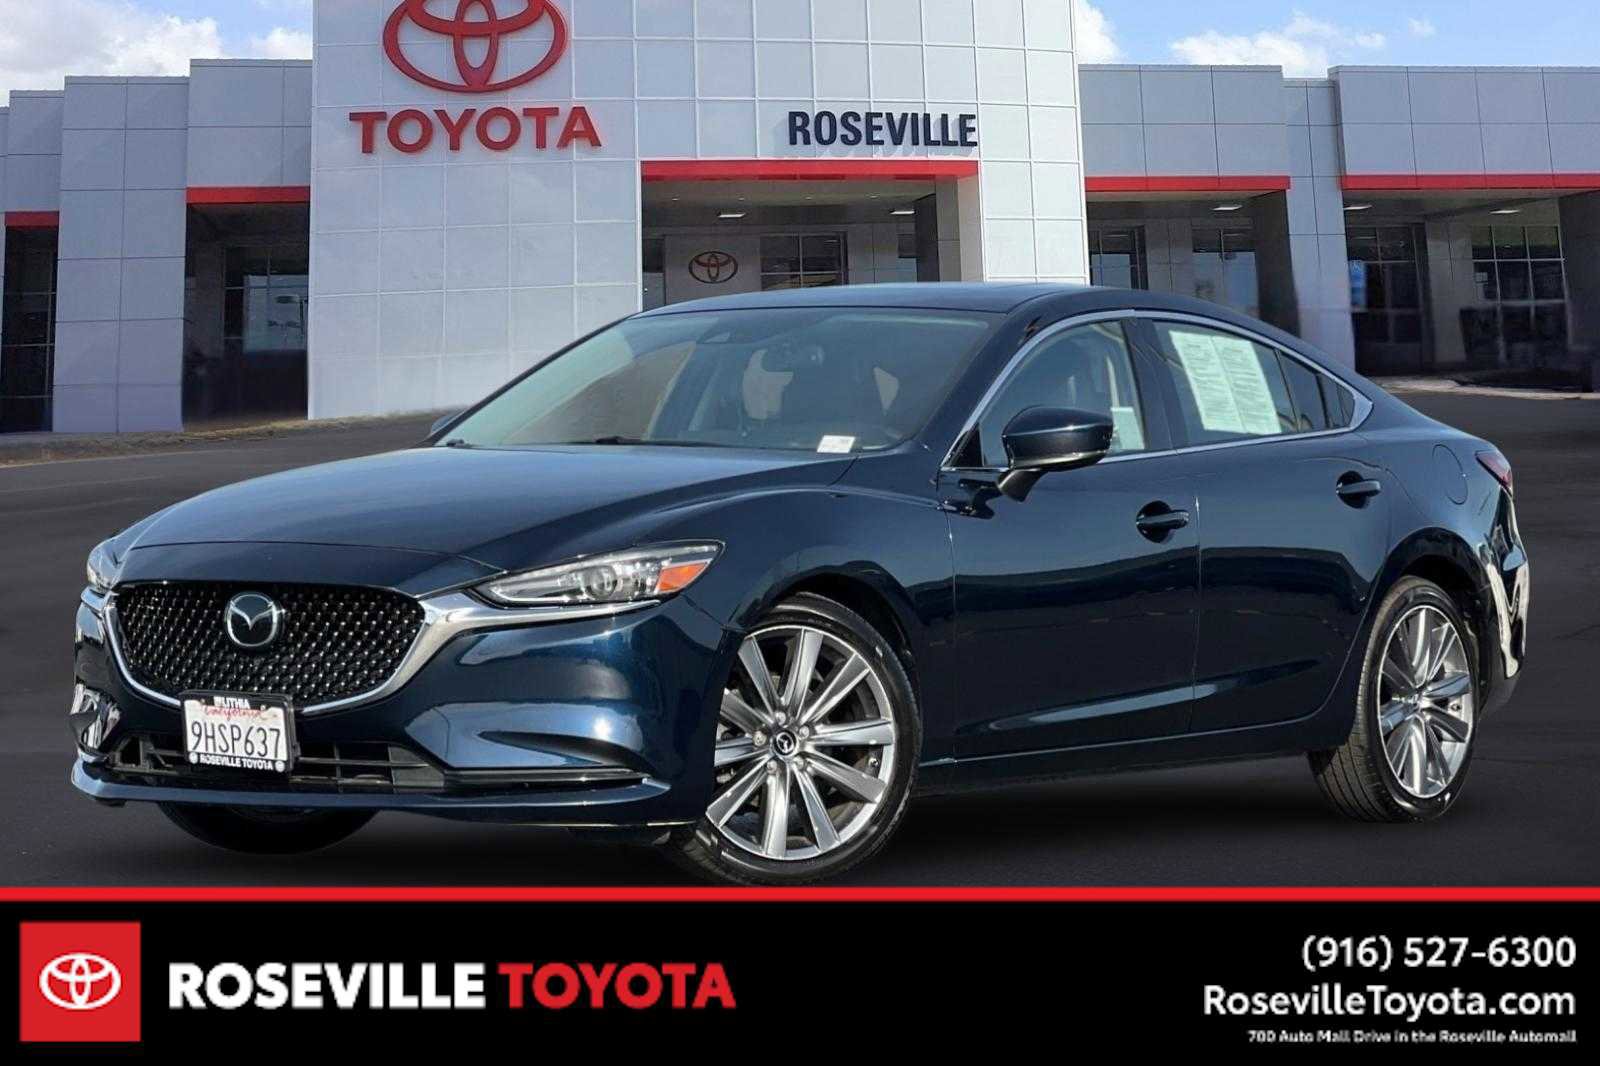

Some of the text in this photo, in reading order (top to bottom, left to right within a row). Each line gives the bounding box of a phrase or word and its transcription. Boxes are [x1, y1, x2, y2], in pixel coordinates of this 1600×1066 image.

[349, 106, 602, 154] TOYOTA
[789, 111, 978, 148] ROSEVILLE
[191, 721, 281, 759] 9HSP637
[199, 753, 274, 771] ROSEVILLE TOYOTA
